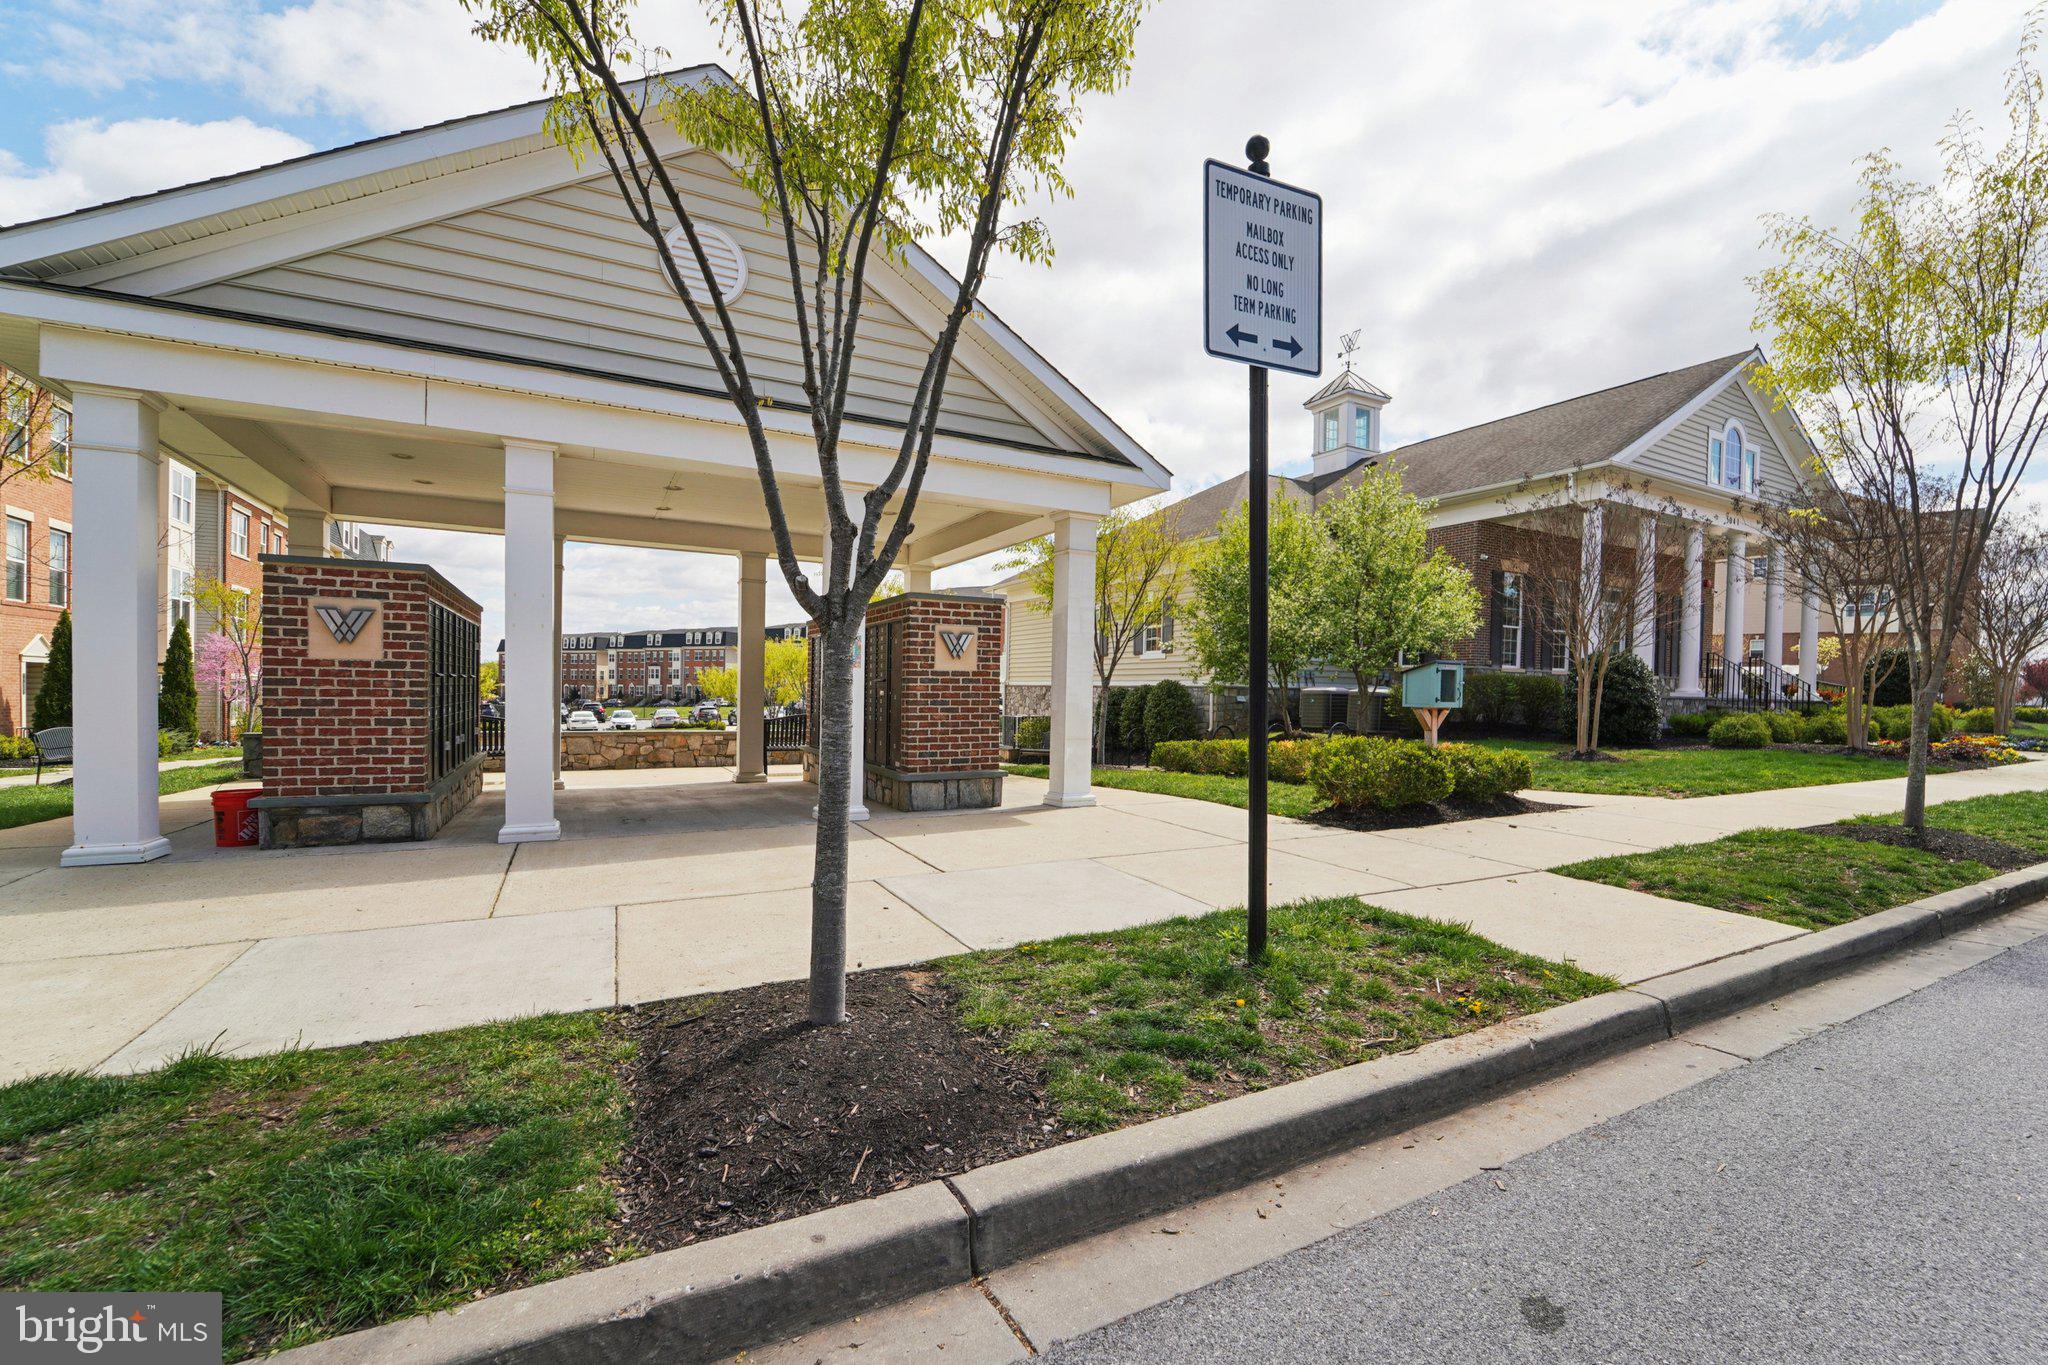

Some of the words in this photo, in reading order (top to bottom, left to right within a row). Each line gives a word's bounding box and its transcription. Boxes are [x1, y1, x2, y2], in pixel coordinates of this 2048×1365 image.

[1215, 179, 1271, 212] TEMPORARY
[1273, 198, 1313, 225] PARKING
[1246, 221, 1284, 247] MAILBOX
[1235, 241, 1269, 265] ACCESS
[1271, 251, 1295, 271] ONLY
[1246, 274, 1259, 292] NO
[1261, 278, 1284, 298] LONG
[1233, 294, 1256, 315] TERM
[1258, 300, 1297, 324] PARKING
